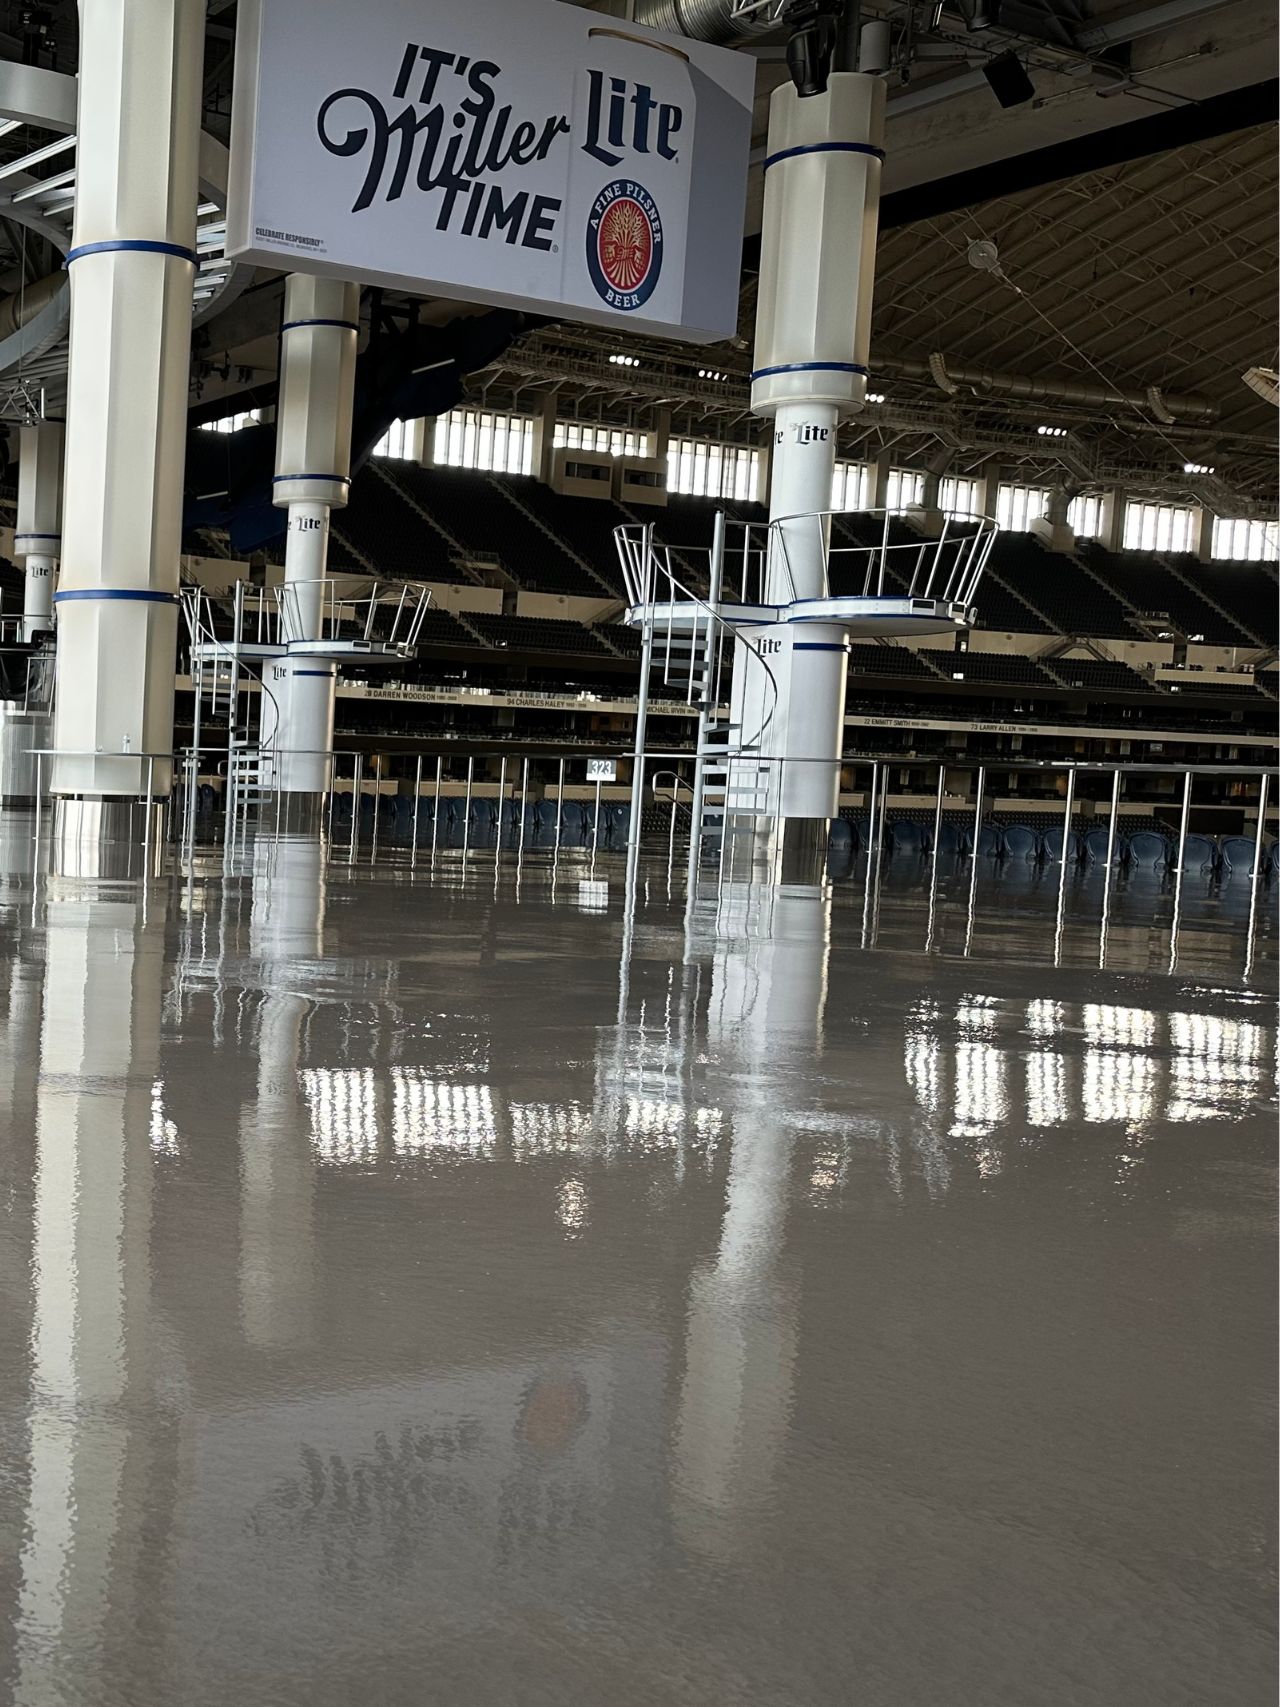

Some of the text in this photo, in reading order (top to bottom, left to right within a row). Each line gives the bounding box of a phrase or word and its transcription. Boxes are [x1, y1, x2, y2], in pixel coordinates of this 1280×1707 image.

[392, 43, 501, 116] IT'S
[581, 69, 682, 167] Lite
[317, 88, 570, 213] Miller
[435, 177, 562, 251] TIME
[590, 182, 662, 244] A FINE PILSNER
[255, 227, 285, 241] CELEBRATE
[605, 288, 640, 305] BEER
[795, 425, 829, 445] Lite
[297, 516, 320, 532] Lite
[32, 565, 49, 579] Lite
[273, 665, 287, 681] Lite
[373, 690, 401, 699] DARREN
[402, 692, 436, 701] WOODSON
[516, 699, 544, 708] CHARLES
[545, 700, 565, 709] HALEY
[970, 723, 978, 731] 73
[591, 760, 612, 775] 323
